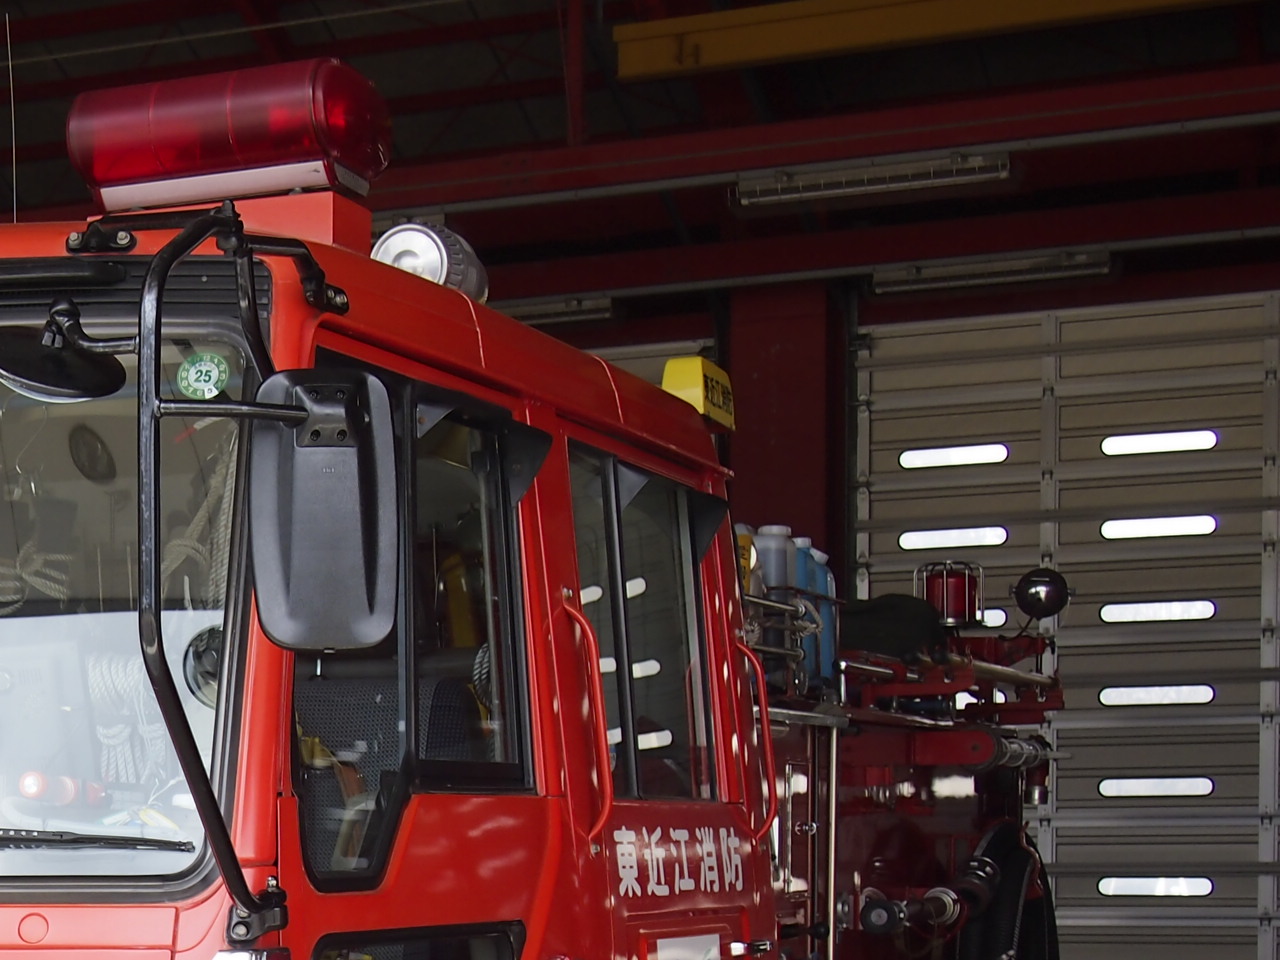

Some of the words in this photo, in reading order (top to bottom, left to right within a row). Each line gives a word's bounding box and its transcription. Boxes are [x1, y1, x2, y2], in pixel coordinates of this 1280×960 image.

[193, 369, 213, 383] 25
[613, 825, 743, 898] 東近江消防
